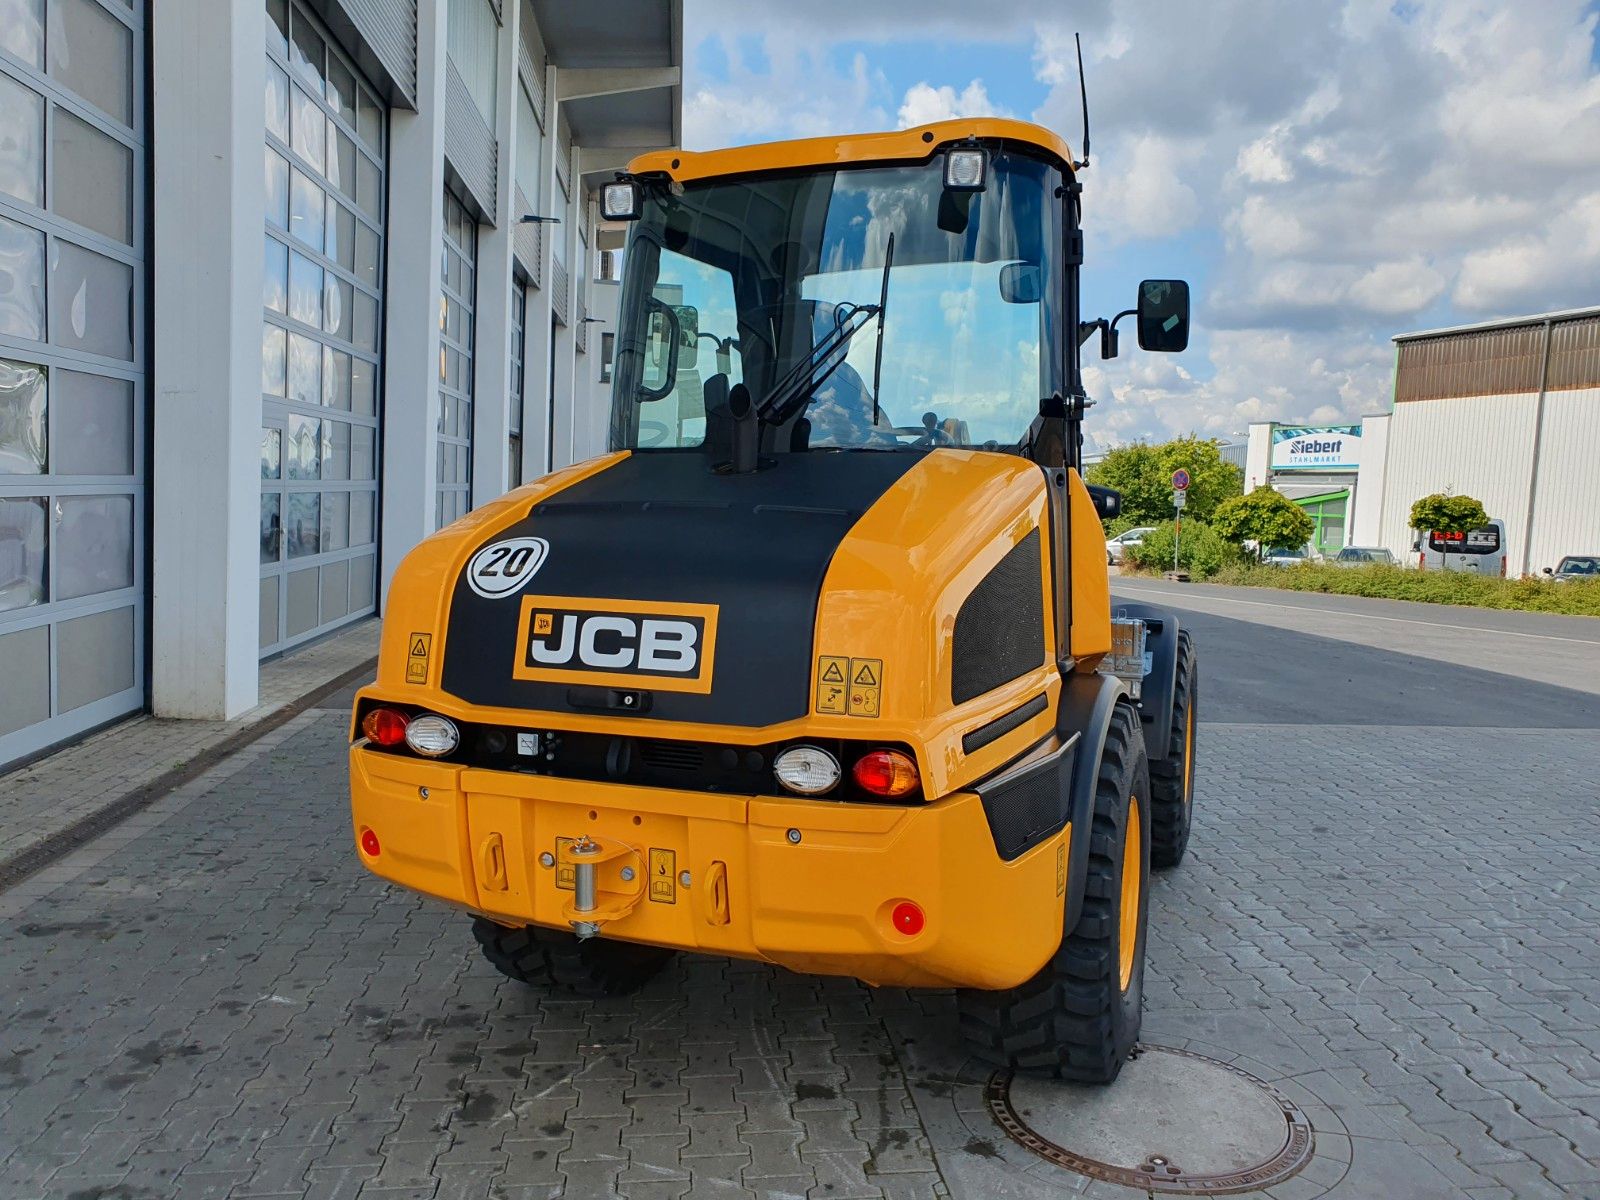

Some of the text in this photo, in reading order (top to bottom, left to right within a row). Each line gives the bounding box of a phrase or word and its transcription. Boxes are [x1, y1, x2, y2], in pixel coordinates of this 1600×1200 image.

[1290, 440, 1342, 453] Siebert
[1289, 455, 1342, 463] STAHLMARKT
[478, 547, 534, 578] 20
[531, 614, 698, 672] JCB
